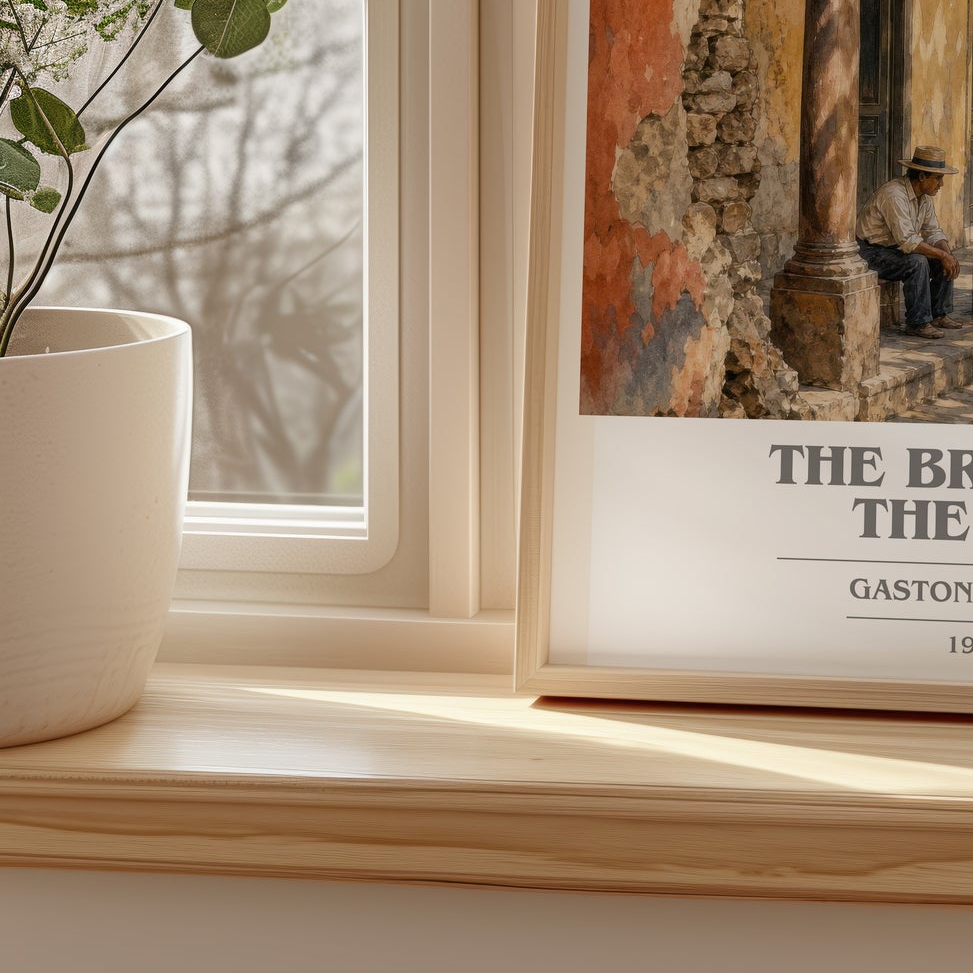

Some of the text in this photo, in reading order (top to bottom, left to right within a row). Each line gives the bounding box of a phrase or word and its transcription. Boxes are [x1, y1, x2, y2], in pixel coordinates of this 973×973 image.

[769, 444, 886, 488] THE
[852, 498, 971, 542] THE
[849, 577, 973, 604] GASTON
